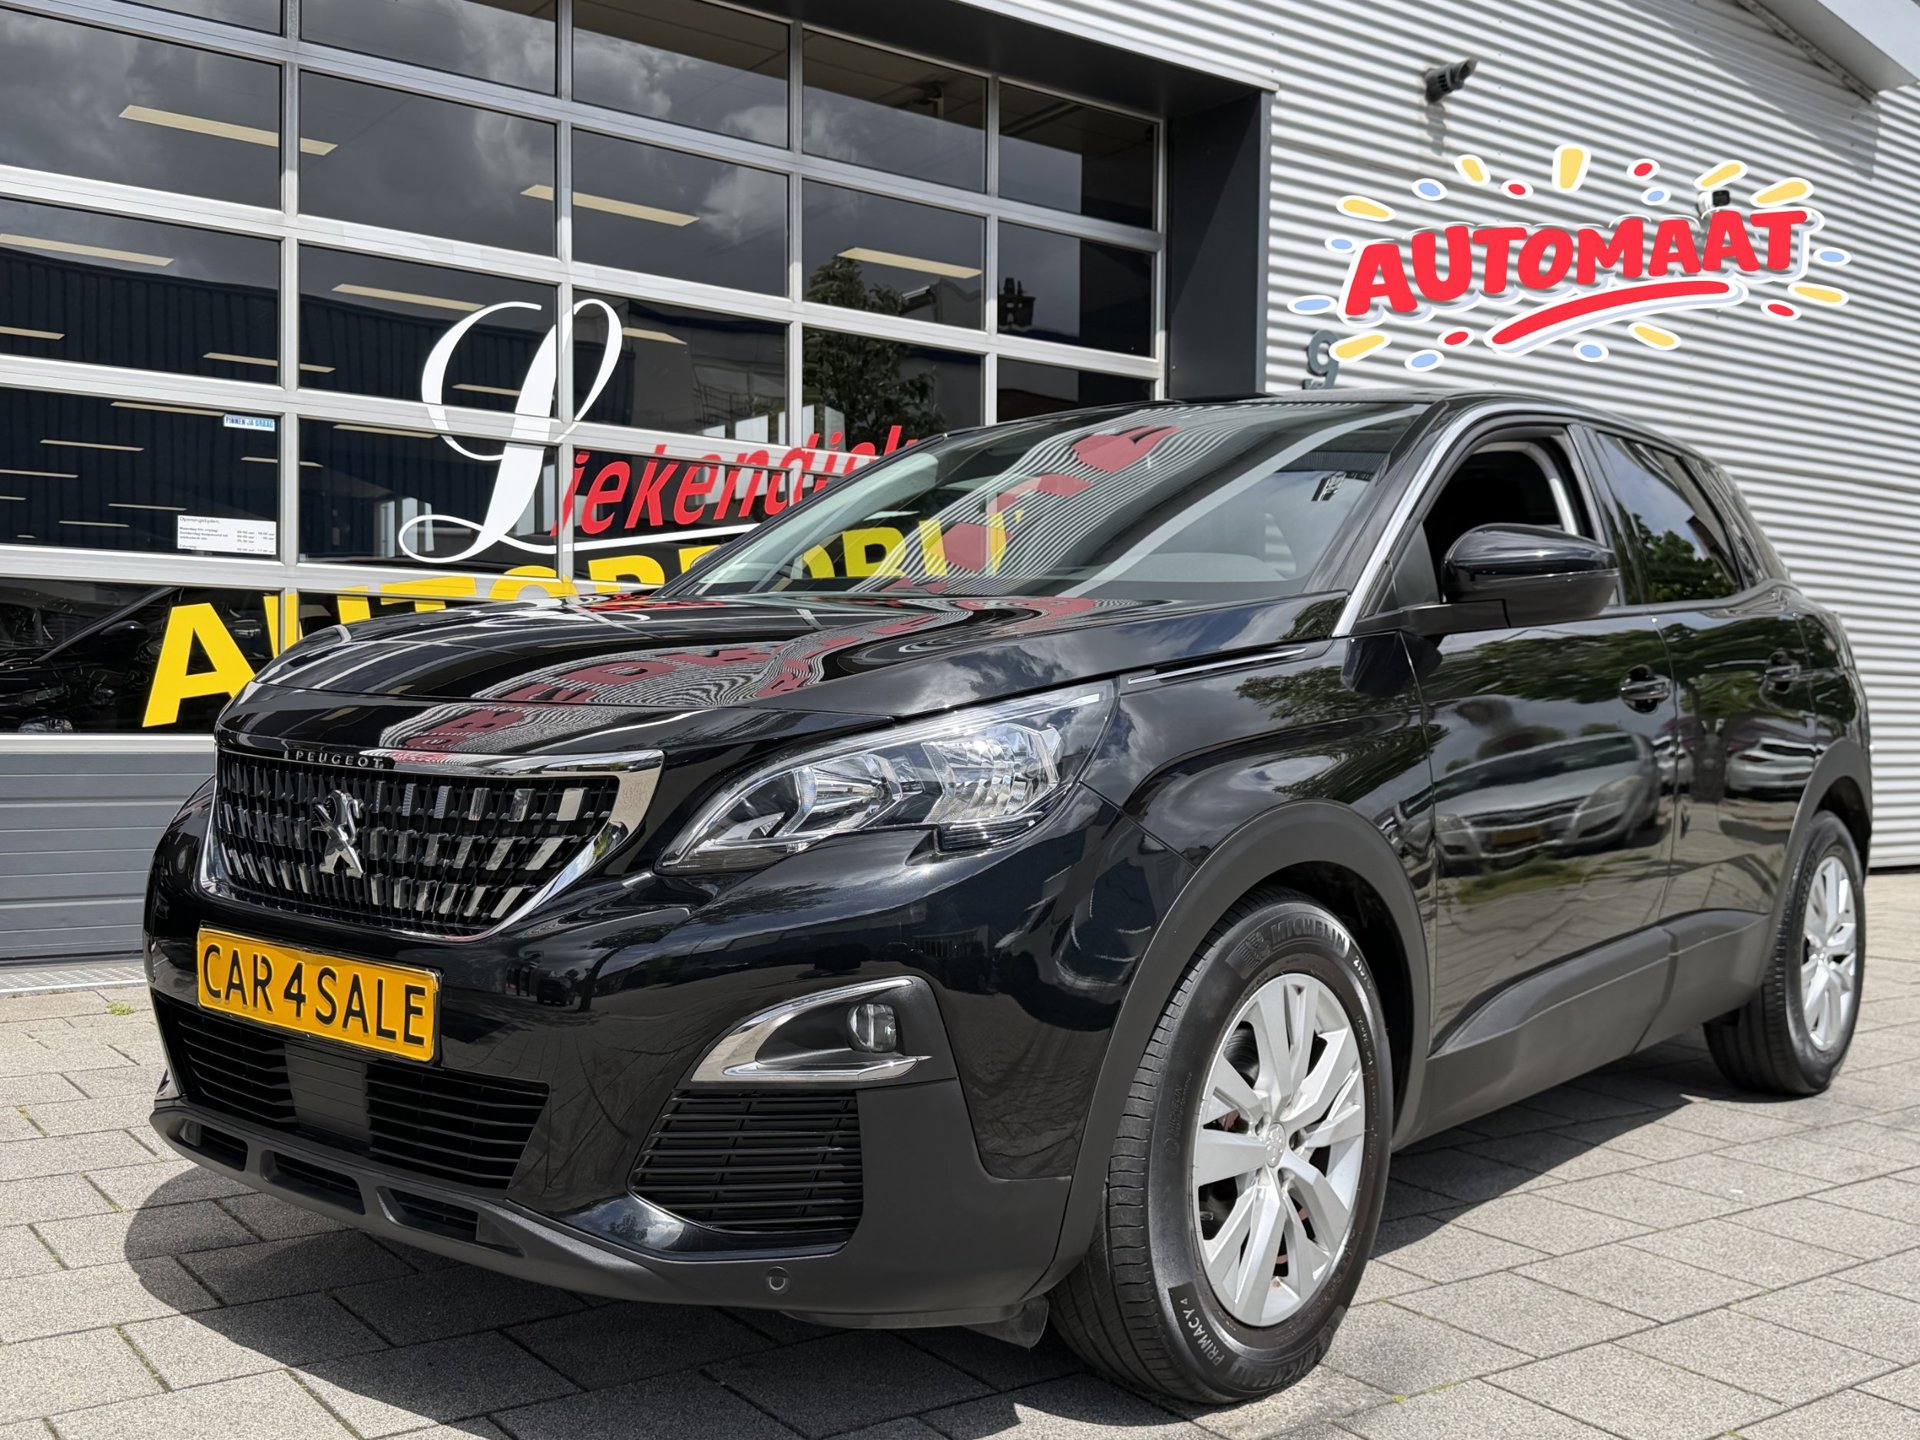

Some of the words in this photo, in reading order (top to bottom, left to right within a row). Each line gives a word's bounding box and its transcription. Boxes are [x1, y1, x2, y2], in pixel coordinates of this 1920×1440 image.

[1308, 329, 1340, 390] 9
[295, 750, 384, 769] PEUGEOT
[1271, 918, 1348, 957] MICHELIN
[1183, 1308, 1225, 1366] PRIMACY
